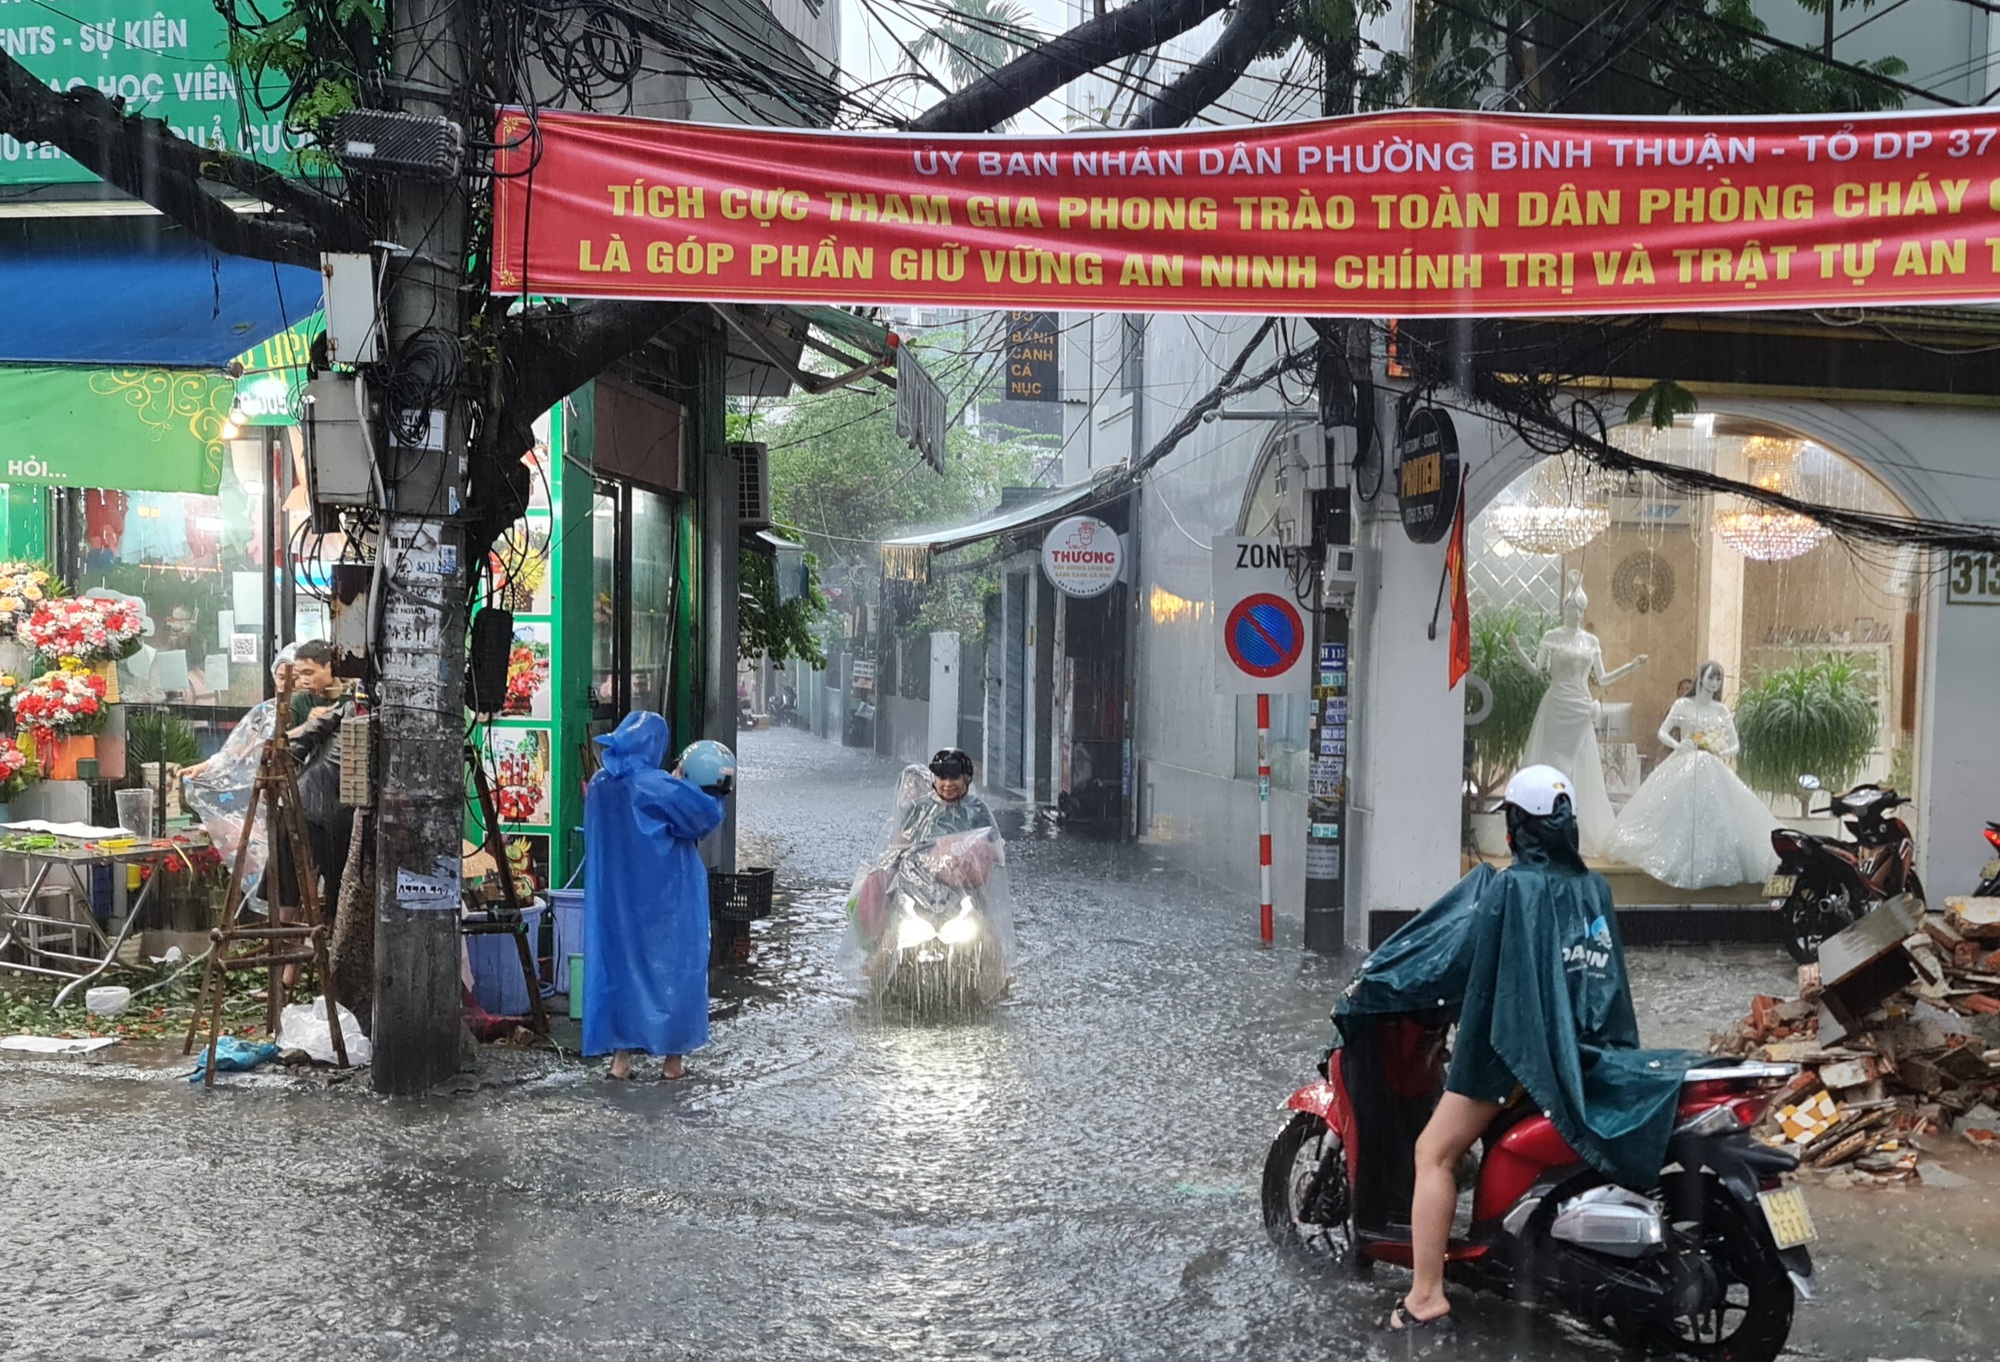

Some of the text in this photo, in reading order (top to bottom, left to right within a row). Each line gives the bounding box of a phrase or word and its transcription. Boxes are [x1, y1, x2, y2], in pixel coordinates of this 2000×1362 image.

[80, 18, 116, 59] SỰ
[124, 11, 187, 56] KIỆN
[98, 73, 164, 111] HỌC
[173, 63, 239, 101] VIÊN
[914, 122, 1993, 177] ỦY BAN NHÂN DÂN PHƯỜNG BÌNH THUẬN - TỔ DP 37
[608, 178, 704, 219] TÍCH
[720, 186, 809, 229] CỰC
[825, 190, 952, 227] THAM
[967, 196, 1043, 229] GIA
[1058, 196, 1218, 231] PHONG
[1233, 188, 1355, 231] TRÀO
[1371, 185, 1499, 230] TOÀN
[1517, 183, 1621, 227] DÂN
[1639, 177, 1814, 225] PHÒNG
[1832, 172, 1970, 219] CHÁY
[579, 233, 631, 273] LÀ
[647, 234, 734, 275] GÓP
[750, 234, 874, 280] PHẦN
[890, 242, 970, 283] GIỮ
[979, 243, 1103, 286] VỮNG
[1119, 253, 1184, 287] AN
[1200, 254, 1317, 289] NINH
[1334, 248, 1482, 289] CHÍNH
[1499, 252, 1574, 294] TRỊ
[1593, 243, 1656, 286] VÀ
[1673, 240, 1797, 289] TRẬT
[1813, 238, 1882, 285] TỰ
[1892, 239, 1967, 276] AN
[1011, 362, 1032, 376] CÁ
[1011, 382, 1042, 397] NỤC
[1052, 551, 1115, 563] THƯƠNG
[1236, 544, 1295, 569] ZONE
